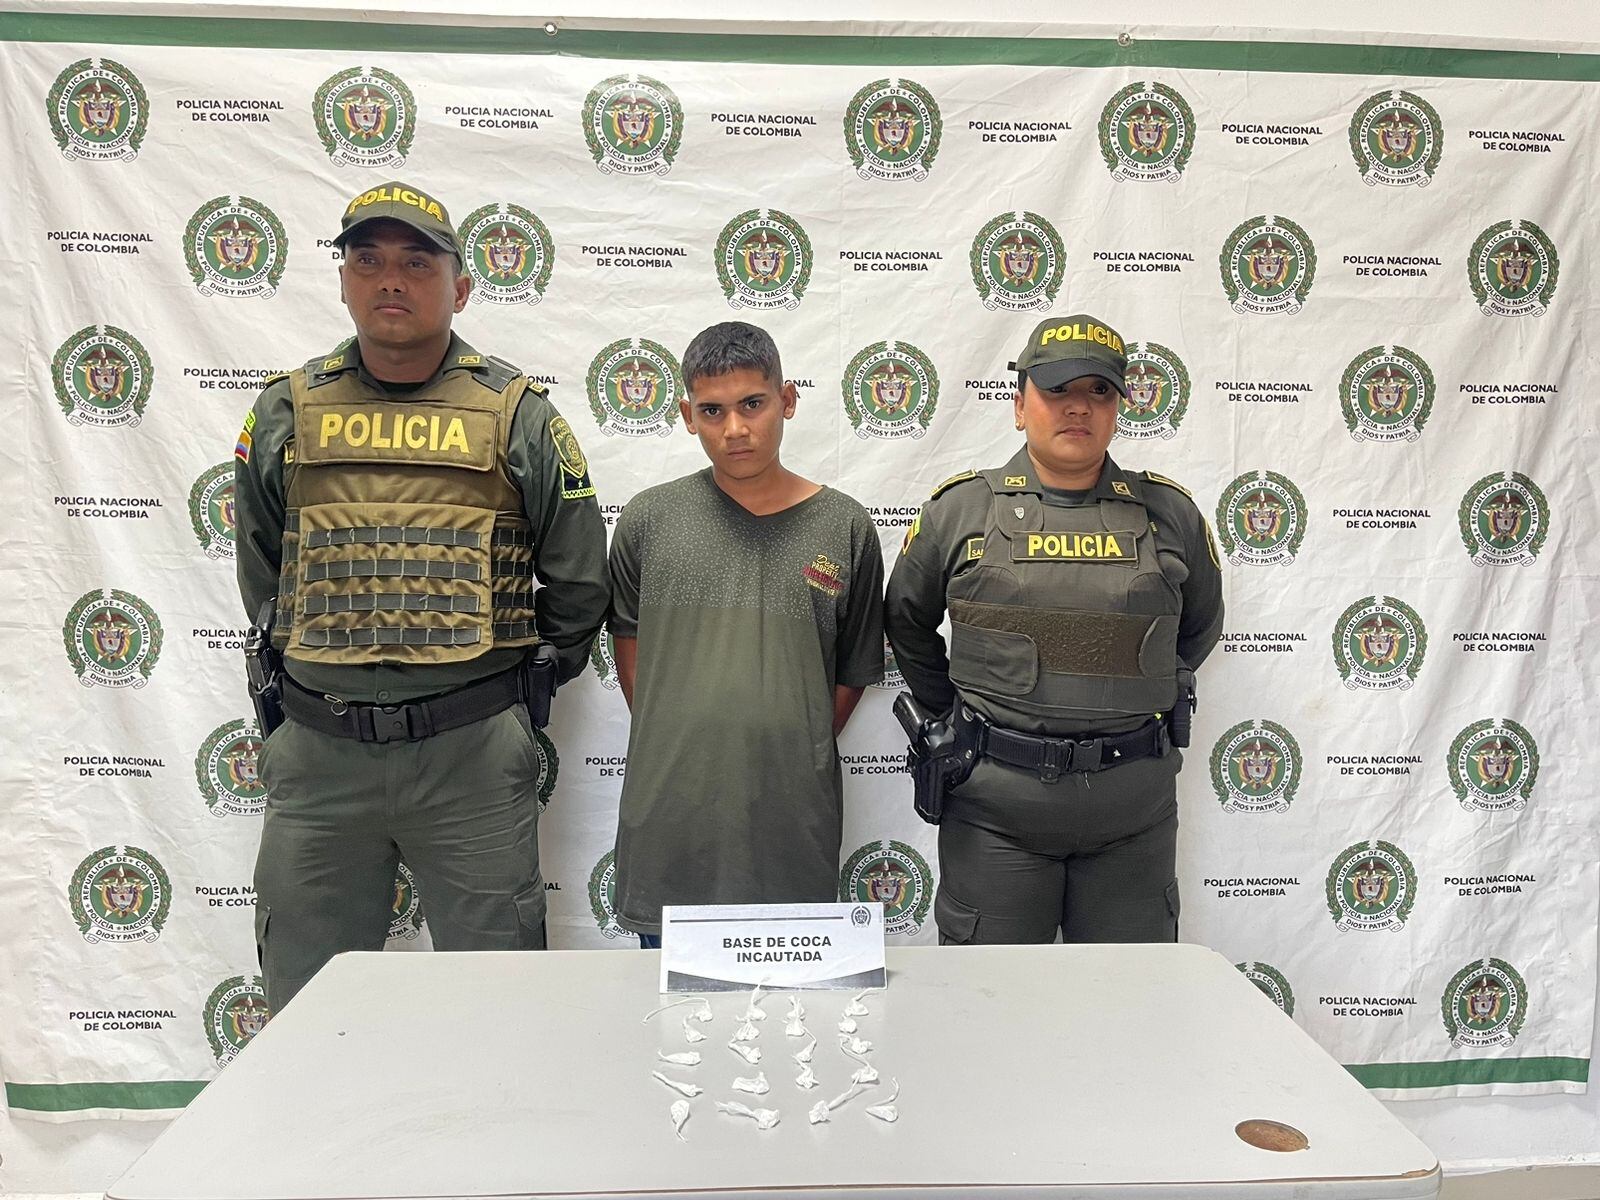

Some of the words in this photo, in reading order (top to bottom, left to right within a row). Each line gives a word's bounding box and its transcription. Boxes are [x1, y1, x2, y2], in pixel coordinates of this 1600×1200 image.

[60, 74, 85, 115] REPUBLICA
[111, 75, 137, 117] COLOMBIA
[176, 99, 222, 109] POLICIA
[223, 99, 285, 110] NACIONAL
[191, 112, 207, 122] DE
[209, 112, 271, 123] COLOMBIA
[445, 106, 491, 116] POLICIA
[493, 107, 554, 118] NACIONAL
[460, 118, 476, 128] DE
[477, 118, 539, 130] COLOMBIA
[711, 113, 756, 124] POLICIA
[757, 114, 817, 126] NACIONAL
[725, 125, 741, 136] DE
[742, 126, 802, 138] COLOMBIA
[968, 120, 1012, 131] POLICIA
[1013, 121, 1072, 132] NACIONAL
[1221, 123, 1265, 134] POLICIA
[1266, 125, 1324, 135] NACIONAL
[64, 125, 90, 147] POLICIA
[100, 126, 134, 149] NACIONAL
[982, 133, 997, 143] DE
[998, 133, 1058, 143] COLOMBIA
[1235, 135, 1250, 145] DE
[1251, 136, 1310, 146] COLOMBIA
[1468, 130, 1511, 140] POLICIA
[1512, 131, 1566, 142] NACIONAL
[1482, 141, 1497, 151] DE
[1498, 141, 1552, 153] COLOMBIA
[99, 148, 126, 159] PATRIA
[349, 187, 443, 222] POLICIA
[47, 230, 90, 241] POLICIA
[92, 232, 154, 243] NACIONAL
[60, 242, 75, 253] DE
[76, 243, 140, 255] COLOMBIA
[581, 245, 627, 255] POLICIA
[628, 246, 688, 257] NACIONAL
[839, 250, 884, 260] POLICIA
[885, 251, 944, 260] NACIONAL
[1093, 251, 1137, 261] POLICIA
[1138, 251, 1195, 262] NACIONAL
[1342, 255, 1385, 265] POLICIA
[1386, 256, 1442, 266] NACIONAL
[596, 257, 612, 267] DE
[613, 258, 673, 268] COLOMBIA
[853, 262, 869, 272] DE
[870, 262, 929, 272] COLOMBIA
[1106, 263, 1122, 273] DE
[1123, 263, 1182, 273] COLOMBIA
[1355, 267, 1371, 276] DE
[1371, 267, 1428, 277] COLOMBIA
[1041, 323, 1124, 355] POLICIA
[184, 368, 228, 377] POLICIA
[200, 381, 215, 389] DE
[219, 381, 265, 390] COLOMB
[965, 381, 1006, 389] POLICIA
[1215, 381, 1257, 391] POLICIA
[1258, 382, 1314, 392] NACIONAL
[1459, 384, 1501, 393] POLICIA
[1504, 385, 1559, 393] NACIONAL
[1228, 393, 1242, 402] DE
[1243, 393, 1300, 403] COLOMBIA
[1471, 395, 1486, 405] DE
[1487, 395, 1546, 405] COLOMBIA
[319, 412, 470, 454] POLICIA
[54, 496, 97, 506] POLICIA
[99, 497, 164, 508] NACIONAL
[67, 508, 81, 518] DE
[82, 508, 149, 519] COLOMBIA
[1332, 509, 1374, 518] POLICIA
[1375, 509, 1432, 518] NACIONAL
[1346, 520, 1360, 529] DE
[1361, 520, 1417, 529] COLOMBIA
[1028, 535, 1122, 557] POLICIA
[192, 630, 235, 638] POLICIA
[1344, 610, 1368, 648] REPUBLICA
[1392, 610, 1415, 649] COLOMBIA
[1218, 633, 1251, 641] OLICIA
[1253, 632, 1308, 642] NACIONAL
[1452, 632, 1490, 642] POLICIA
[1491, 632, 1548, 641] NACIONAL
[208, 642, 222, 650] DE
[1223, 644, 1238, 653] DE
[1239, 644, 1294, 653] COLOMBIA
[1462, 643, 1476, 652] DE
[1477, 643, 1536, 652] COLOMBIA
[1348, 656, 1370, 677] POLICIA
[1379, 657, 1412, 679] NACIONAL
[1378, 677, 1403, 688] PATRIA
[63, 756, 110, 766] POLICIA
[112, 756, 166, 768] NACIONAL
[586, 758, 626, 766] POLICIA
[1326, 755, 1369, 765] POLICIA
[1370, 755, 1423, 765] NACIONAL
[79, 767, 96, 777] DE
[97, 767, 153, 779] COLOMBIA
[600, 769, 614, 777] DE
[850, 767, 864, 775] DE
[866, 766, 910, 775] COLOMB
[1340, 766, 1355, 776] DE
[1356, 766, 1411, 776] COLOMBIA
[83, 860, 108, 900] REPUBLICA
[135, 860, 159, 900] COLOMBIA
[1203, 878, 1245, 888] POLICIA
[1246, 877, 1301, 886] NACIONAL
[1444, 876, 1485, 886] POLICIA
[1485, 874, 1537, 885] NACIONAL
[196, 887, 239, 896] POLICIA
[1217, 889, 1231, 899] DE
[1232, 887, 1287, 898] COLOMBIA
[1458, 887, 1473, 897] DE
[1473, 884, 1523, 896] COLOMBIA
[209, 899, 223, 907] DE
[88, 909, 114, 930] POLICIA
[123, 908, 156, 931] NACIONAL
[123, 929, 149, 940] PATRIA
[722, 937, 762, 948] BASE
[766, 937, 786, 948] DE
[790, 936, 832, 947] COCA
[736, 951, 823, 963] INCAUTADA
[1319, 996, 1361, 1006] POLICIA
[1362, 997, 1418, 1007] NACIONAL
[69, 1010, 116, 1021] POLICIA
[117, 1009, 177, 1019] NACIONAL
[1332, 1007, 1347, 1017] DE
[1349, 1007, 1404, 1017] COLOMBIA
[83, 1022, 100, 1032] DE
[101, 1021, 163, 1031] COLOMBIA
